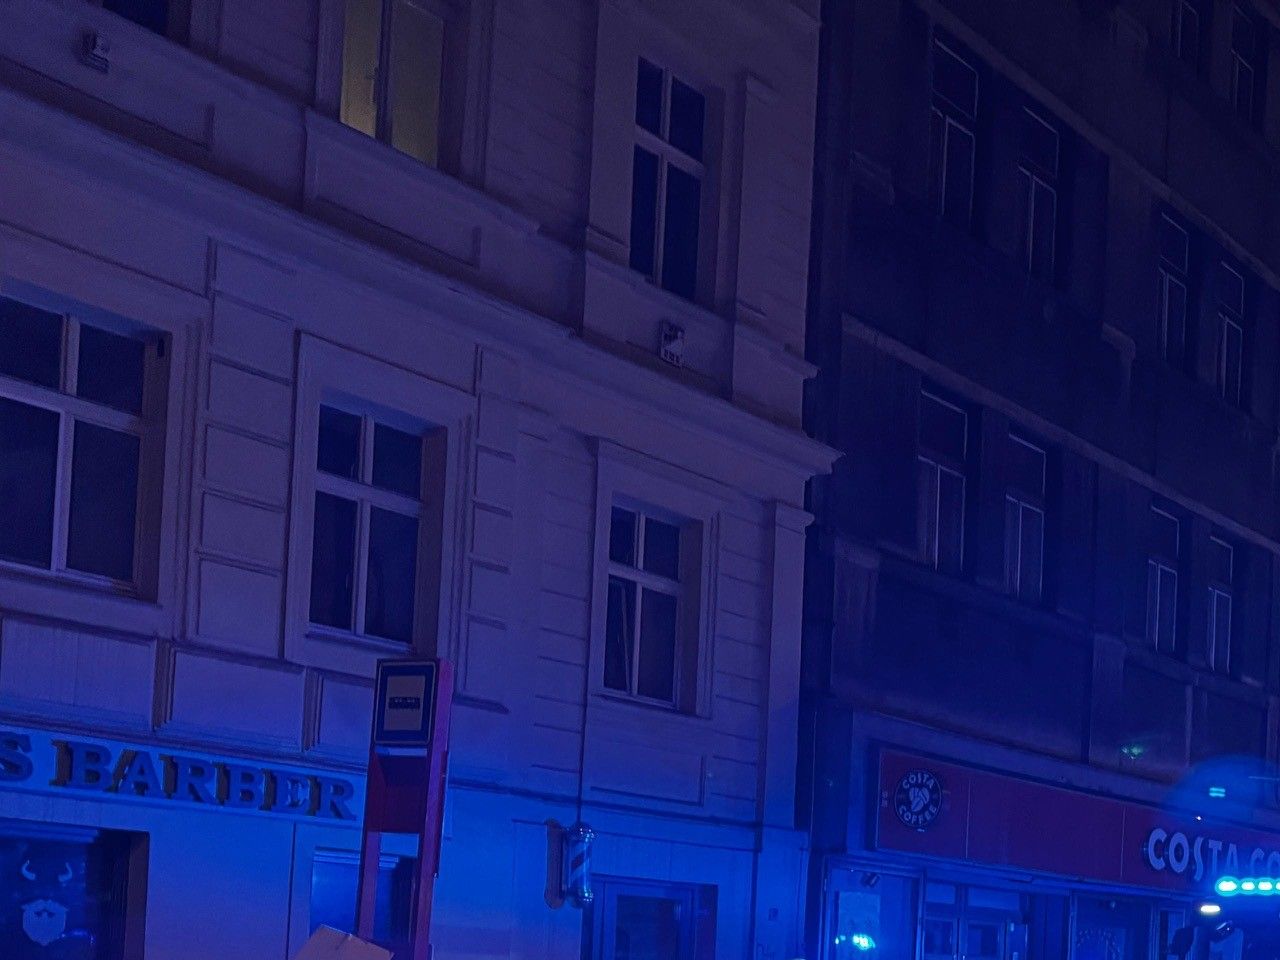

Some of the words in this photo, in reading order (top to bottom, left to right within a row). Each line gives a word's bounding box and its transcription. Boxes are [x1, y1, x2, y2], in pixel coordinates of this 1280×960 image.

[50, 738, 355, 820] BARBER
[902, 772, 935, 789] COSTA
[898, 804, 938, 825] COFFEE
[1147, 827, 1239, 881] COSTA
